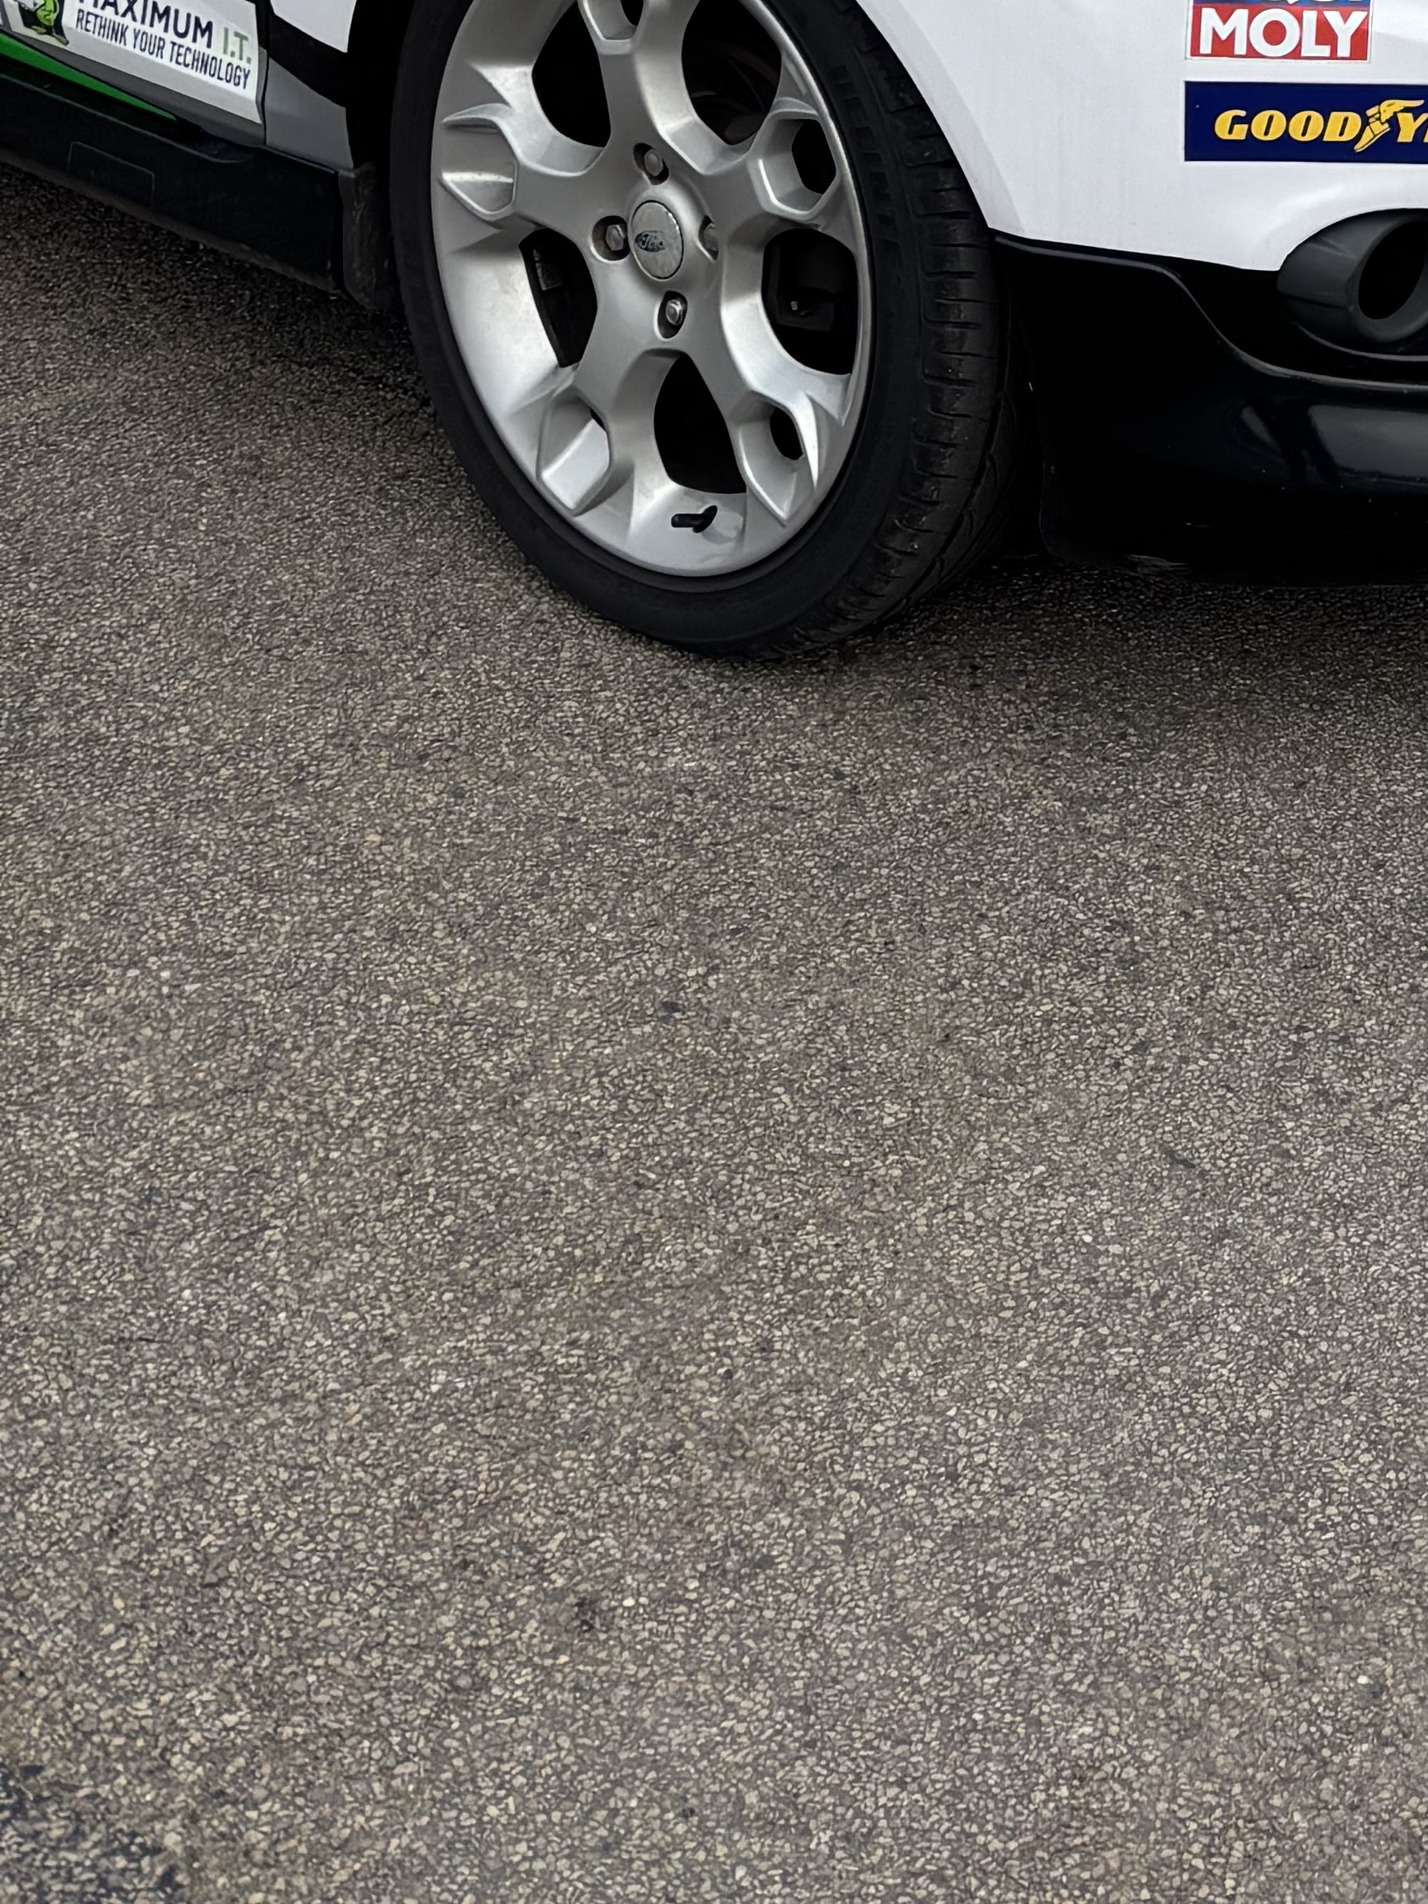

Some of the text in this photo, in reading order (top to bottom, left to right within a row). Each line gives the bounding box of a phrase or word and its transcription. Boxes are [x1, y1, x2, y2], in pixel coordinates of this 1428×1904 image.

[75, 8, 251, 90] RETHINK YOUR TECHNOLOGY
[222, 26, 251, 65] I.T.
[1199, 7, 1368, 59] MOLY
